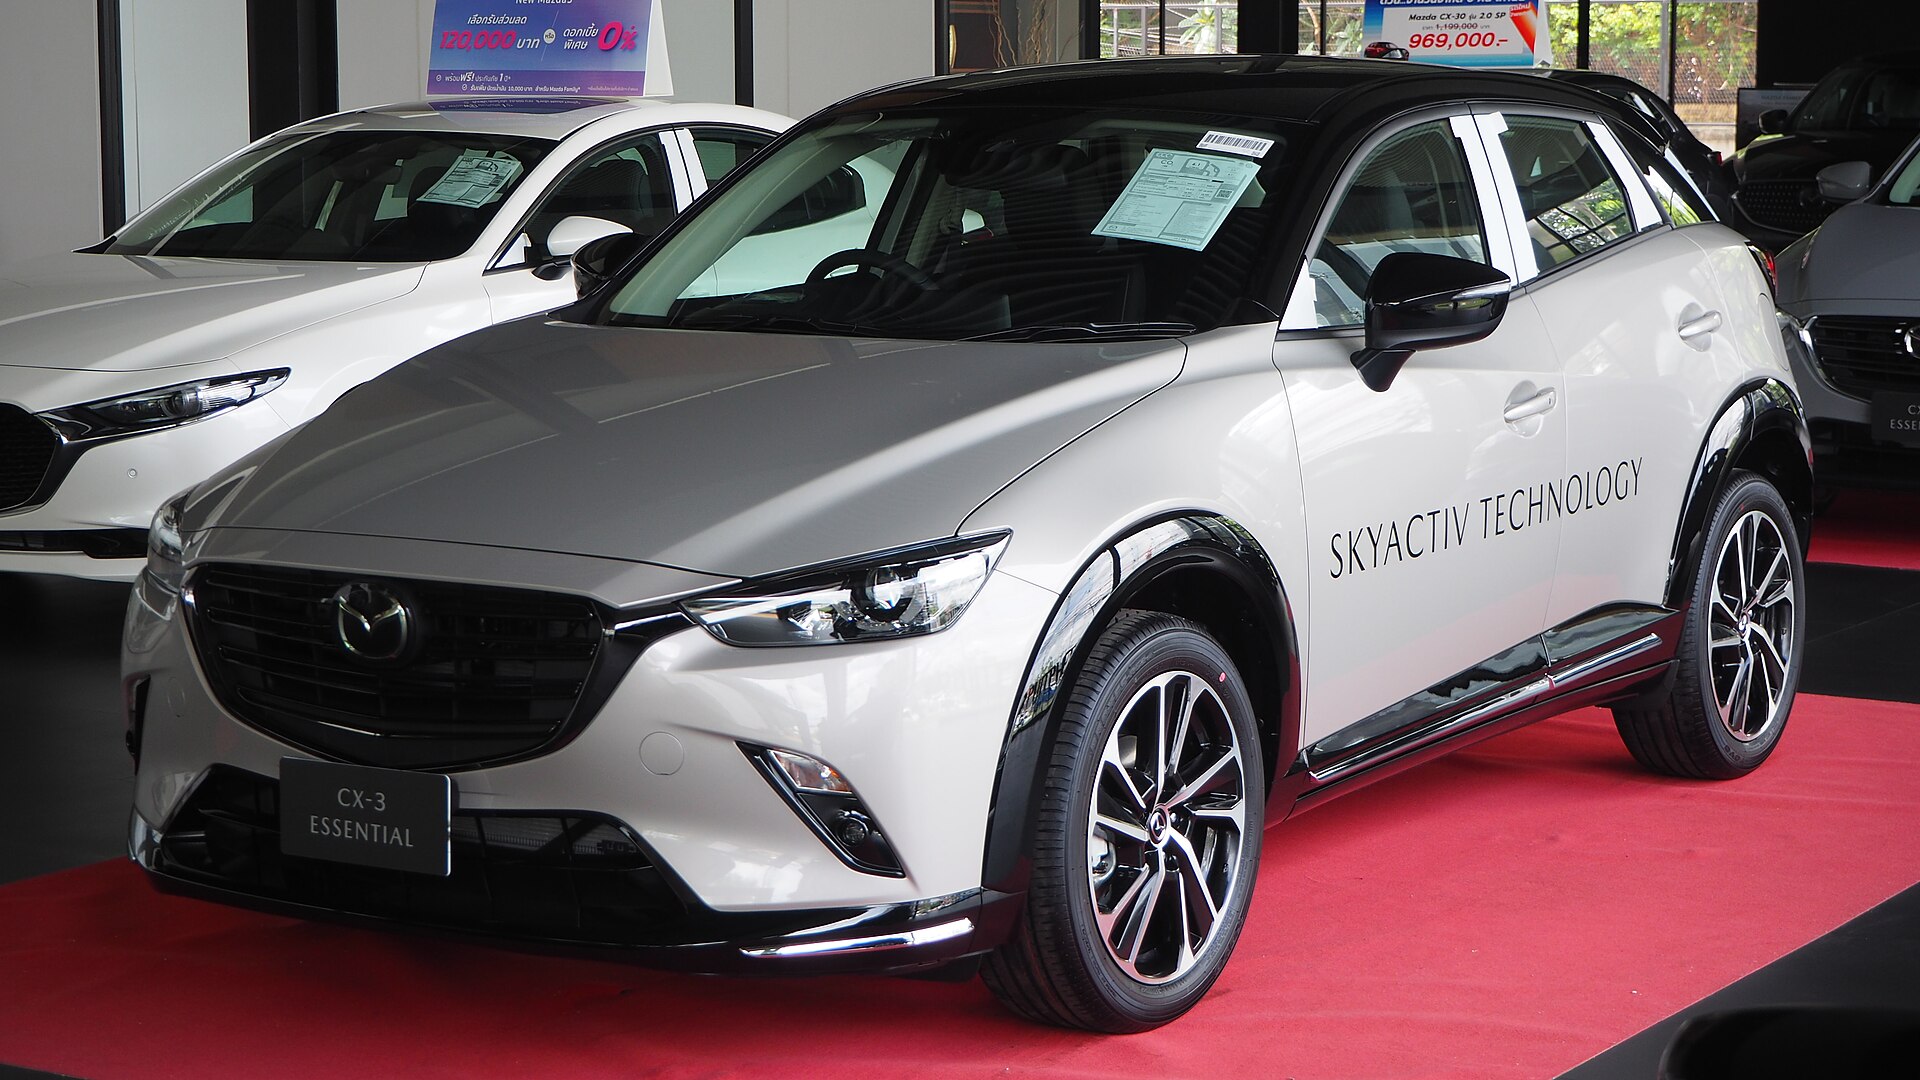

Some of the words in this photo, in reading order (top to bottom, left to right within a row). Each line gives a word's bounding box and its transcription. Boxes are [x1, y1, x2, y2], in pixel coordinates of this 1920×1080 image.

[467, 14, 528, 25] เลือกรับส่วนลด
[1409, 13, 1437, 21] Mazda
[1440, 12, 1466, 20] CX-30
[563, 23, 599, 37] ดอกเบี้ย
[1436, 22, 1478, 31] 1,199,000
[439, 30, 517, 52] 120,000
[516, 38, 541, 49] บาท
[564, 39, 589, 50] พิเศษ
[1409, 32, 1508, 51] 969,000.-
[1890, 419, 1920, 431] ESSE
[1330, 502, 1470, 579] SKYACTIV
[1480, 457, 1643, 540] TECHNOLOGY
[337, 787, 386, 812] CX-3
[310, 815, 414, 847] ESSENTIAL
